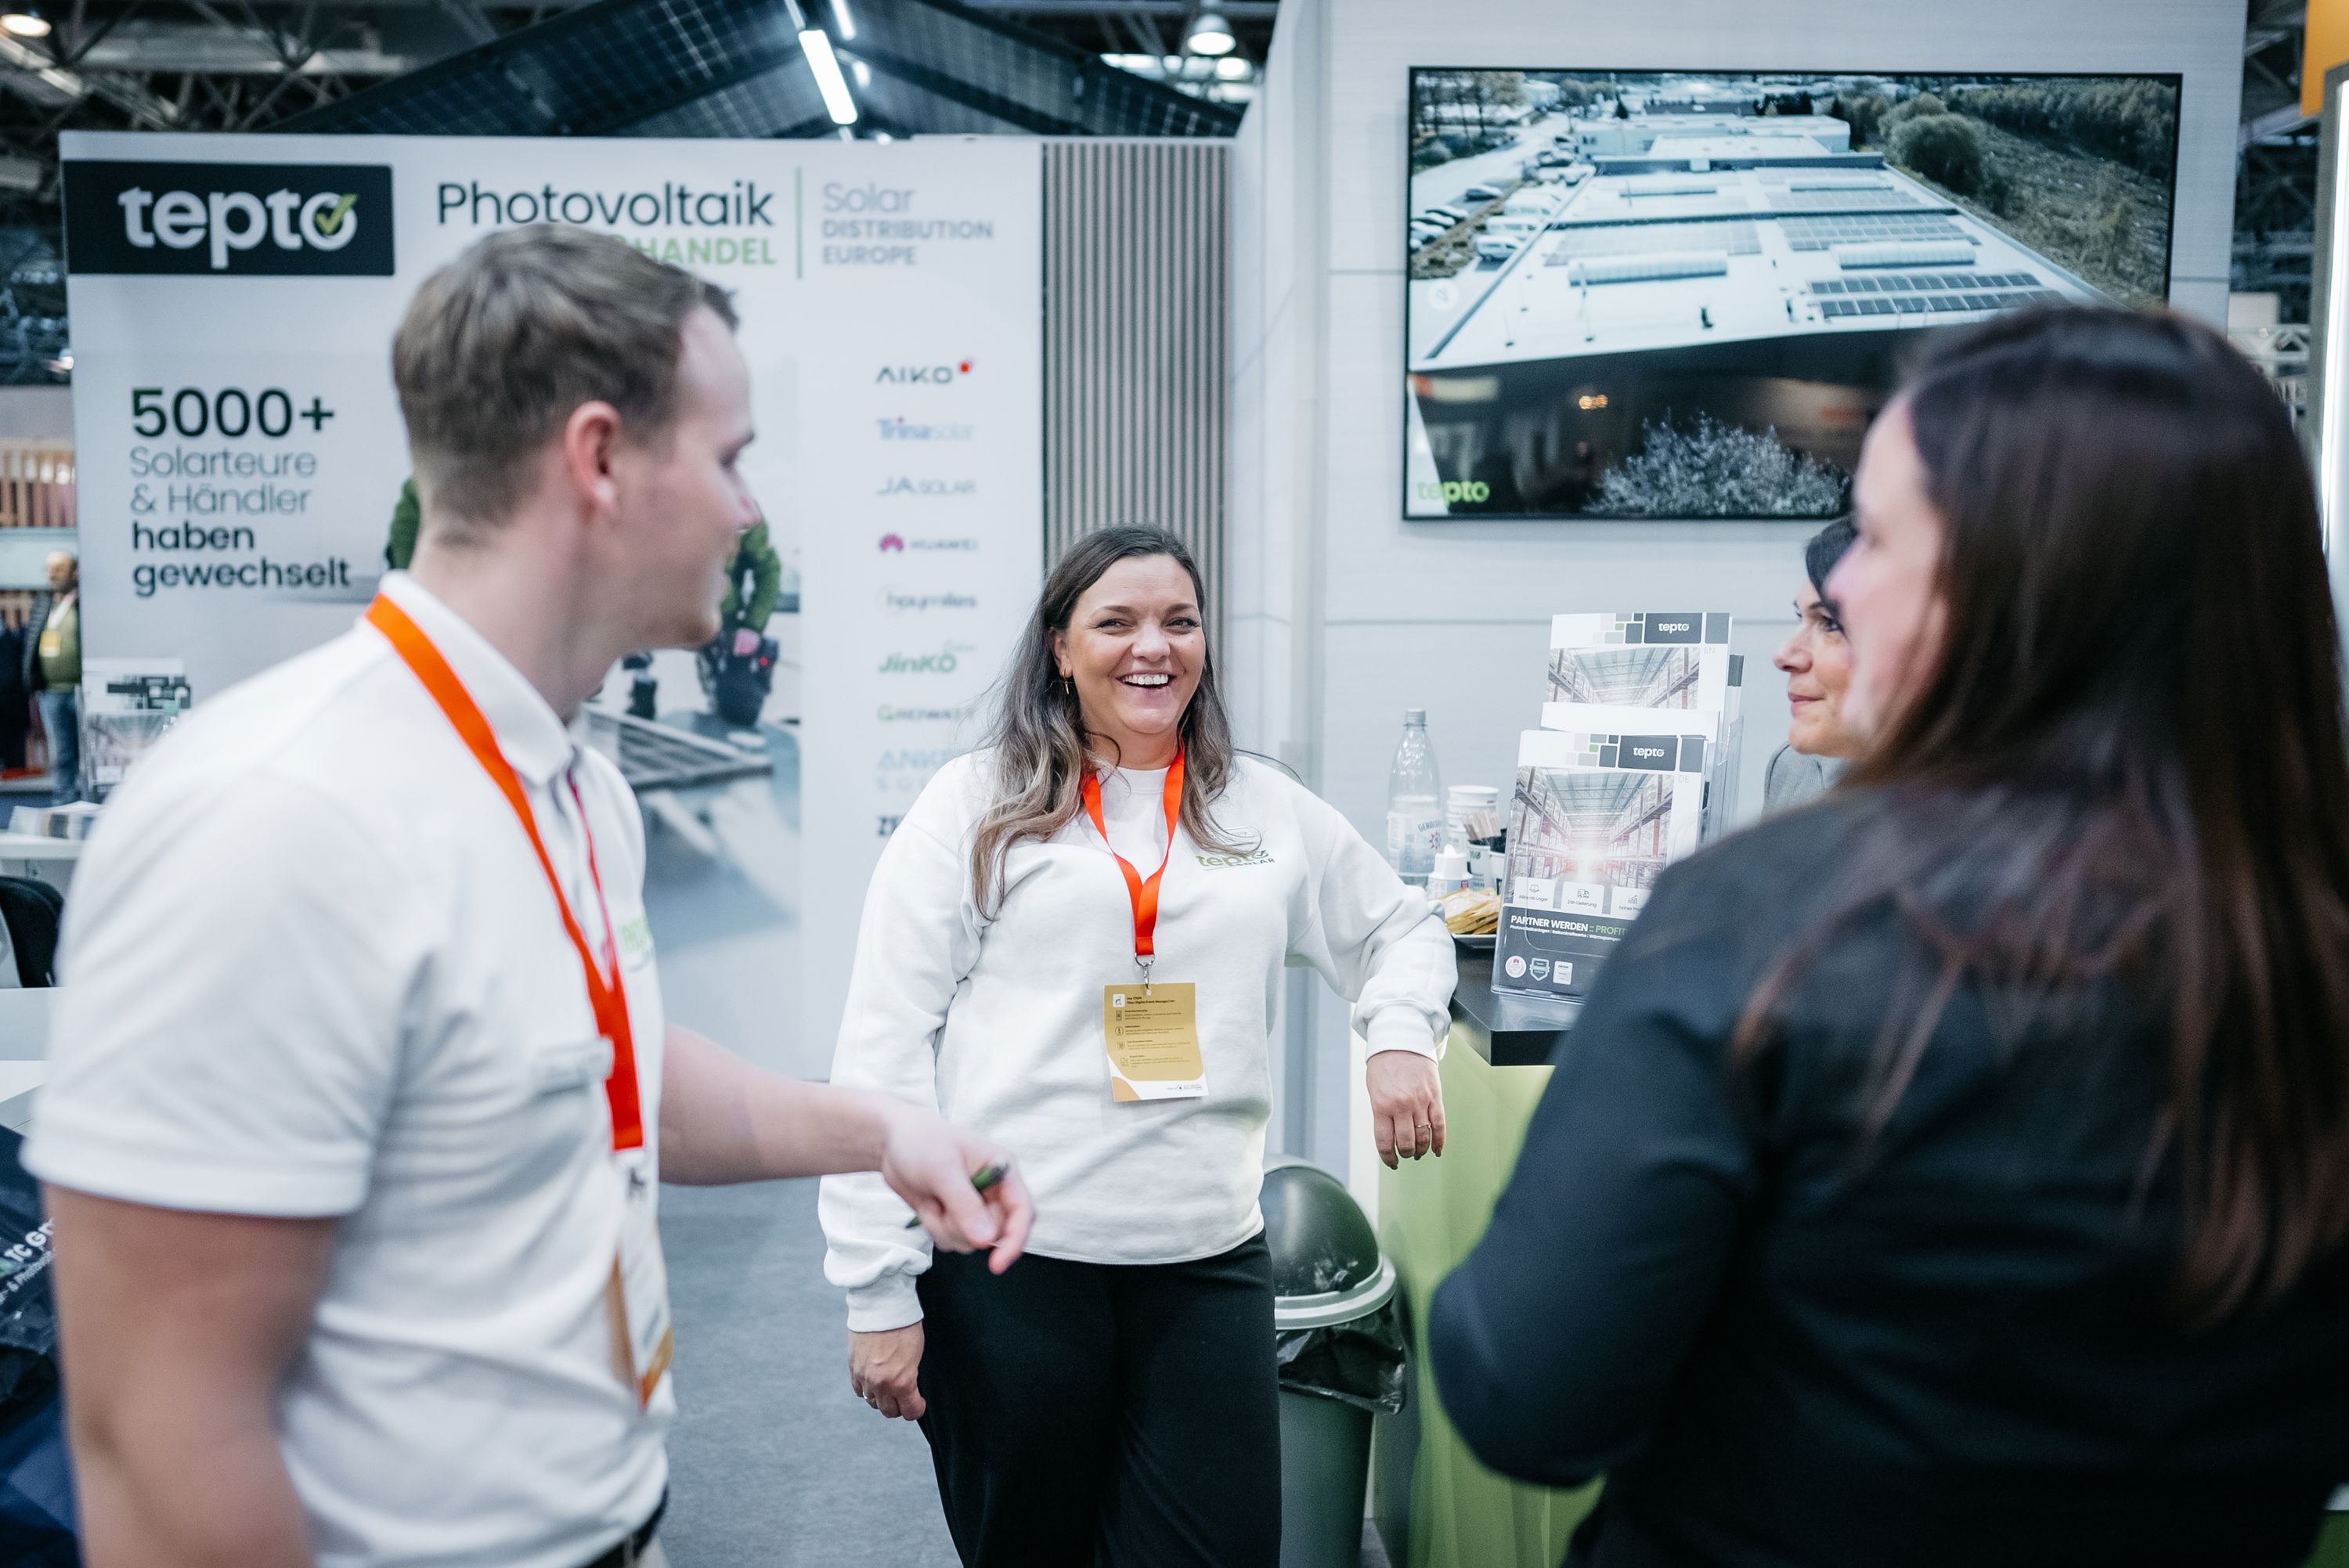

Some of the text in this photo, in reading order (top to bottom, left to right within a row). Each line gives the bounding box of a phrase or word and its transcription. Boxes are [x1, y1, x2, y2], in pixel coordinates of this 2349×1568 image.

[438, 181, 776, 226] Photovoltaik
[822, 182, 914, 214] Solar
[118, 186, 357, 269] tepto
[822, 220, 994, 240] DISTRIBUTION
[609, 234, 775, 265] HANDEL
[822, 245, 916, 265] EUROPE
[876, 366, 953, 384] AIKO
[132, 387, 335, 438] 5000+
[129, 445, 318, 479] Solarteure
[129, 481, 312, 515] & Händler
[1417, 480, 1490, 506] tepto
[132, 521, 254, 551] haben
[132, 556, 351, 599] gewechselt
[1658, 622, 1690, 633] tepto
[1633, 746, 1665, 759] tepto
[1511, 915, 1550, 928] PARTNER
[1550, 919, 1589, 932] WERDEN
[1595, 925, 1629, 935] PROFIT
